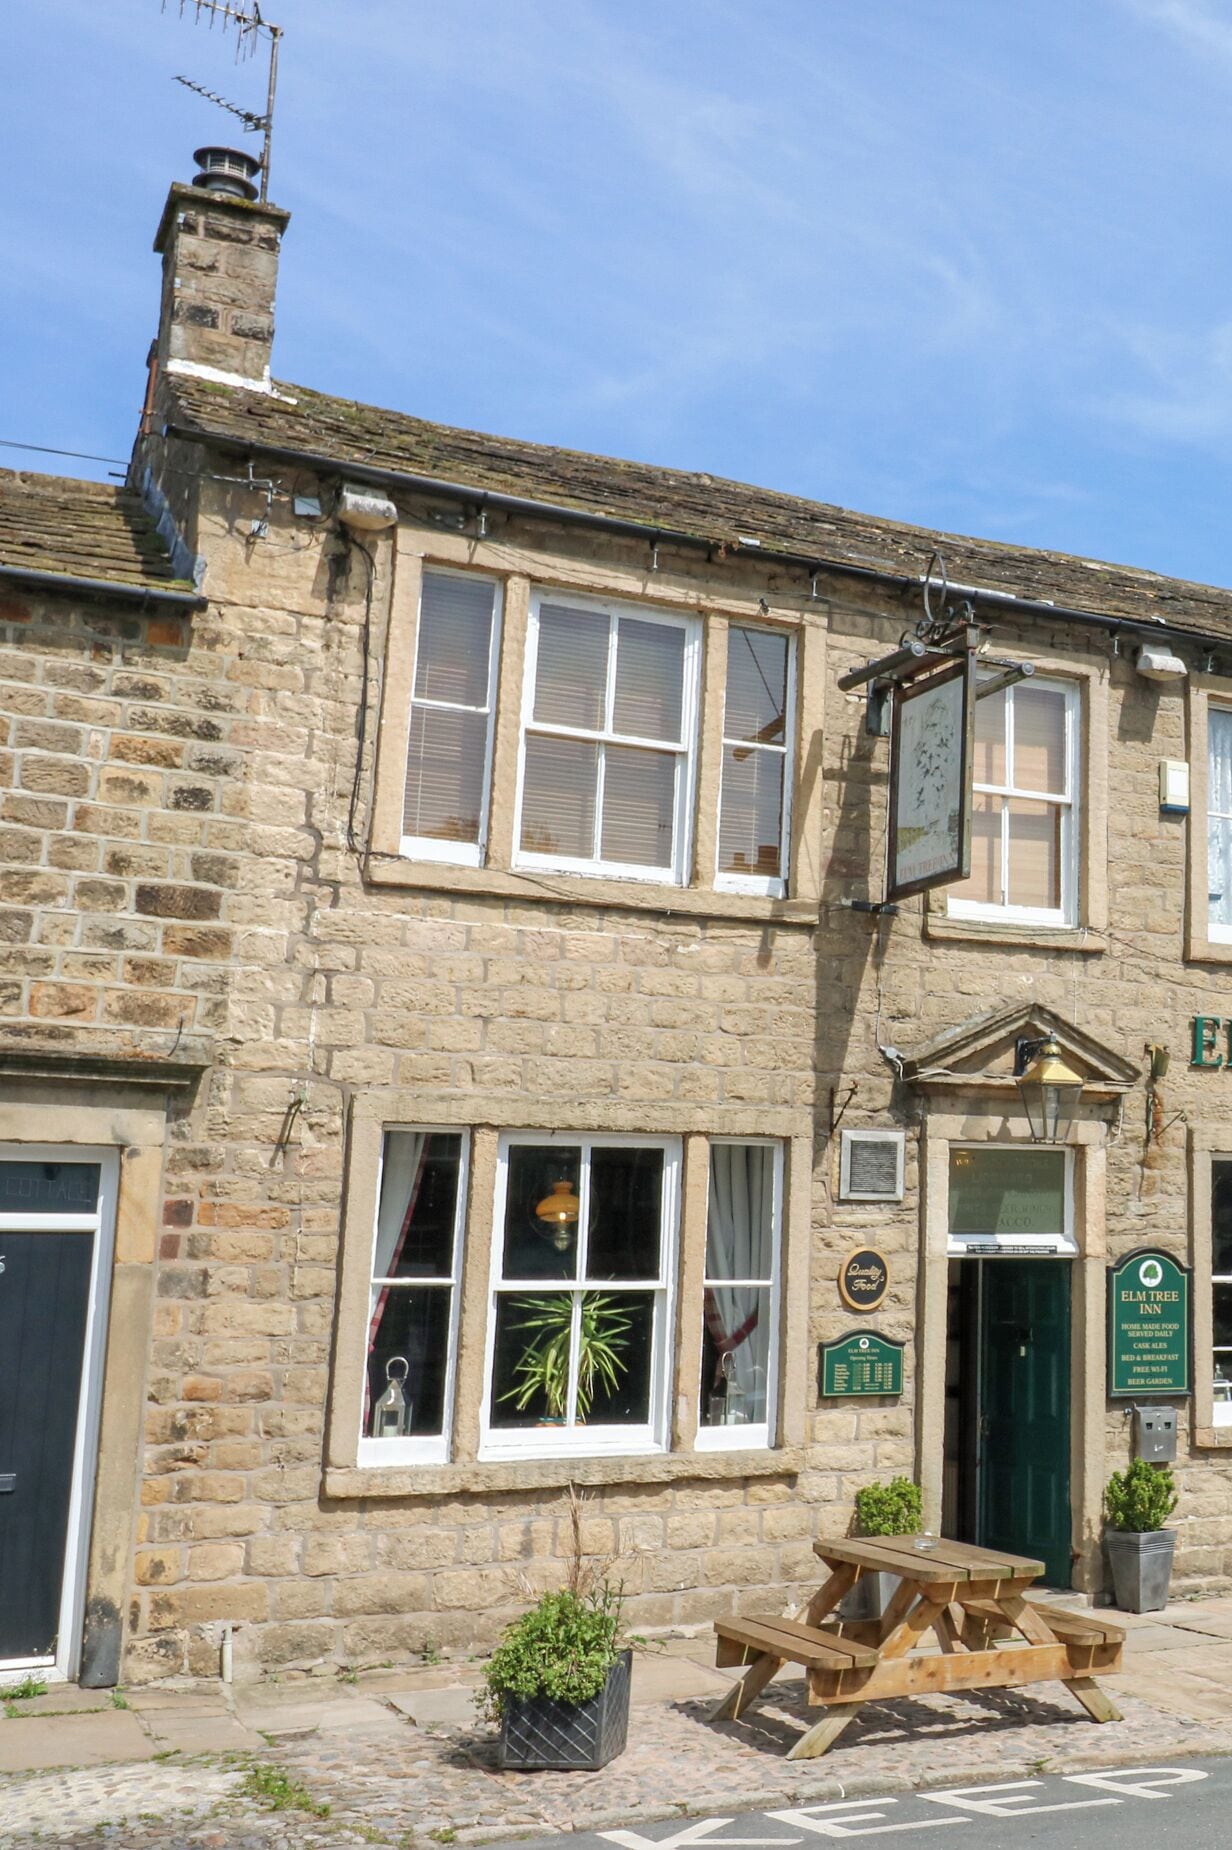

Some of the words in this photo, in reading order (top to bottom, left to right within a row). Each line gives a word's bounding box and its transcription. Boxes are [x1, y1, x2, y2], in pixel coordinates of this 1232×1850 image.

[847, 1263, 885, 1281] Quality
[851, 1279, 879, 1291] Food
[1121, 1290, 1147, 1302] ELM
[1149, 1290, 1179, 1302] TREE
[1139, 1303, 1162, 1314] INN
[1161, 1322, 1179, 1330] FOOD
[1146, 1377, 1173, 1385] GARDEN
[595, 1766, 1210, 1850] KEEP
